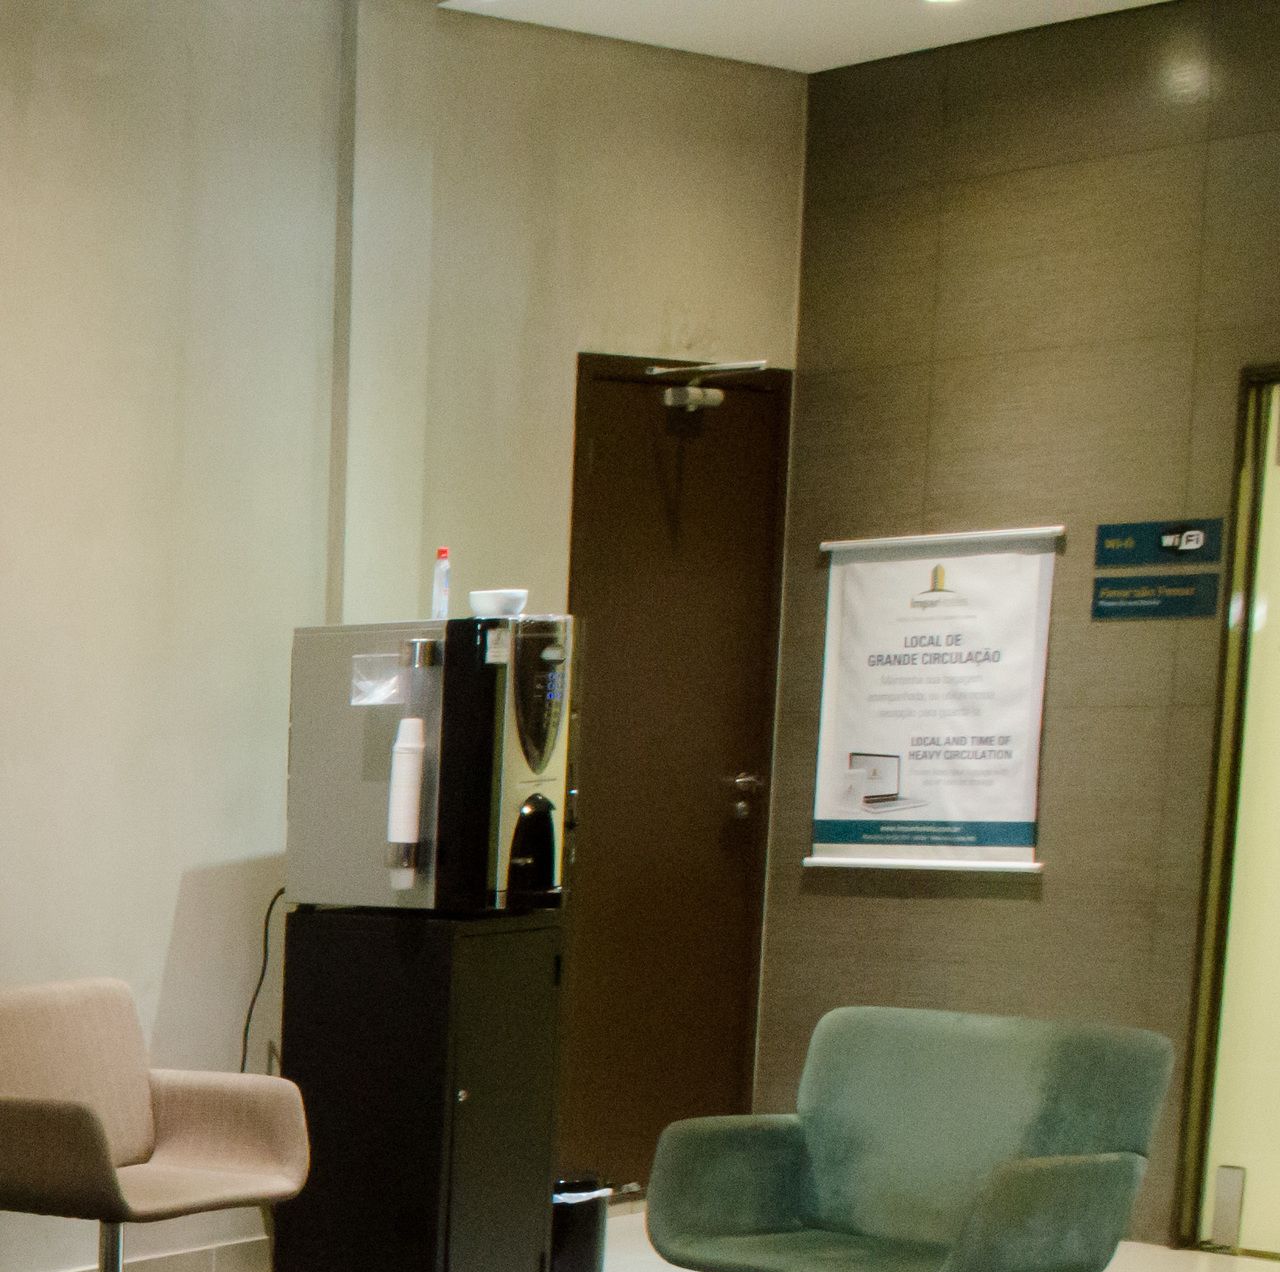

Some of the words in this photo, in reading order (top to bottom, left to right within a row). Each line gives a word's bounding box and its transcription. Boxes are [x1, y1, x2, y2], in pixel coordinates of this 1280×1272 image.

[904, 635, 942, 648] LOCAL
[945, 634, 963, 647] DE
[867, 653, 918, 667] GRANDE
[921, 647, 1002, 667] CIRCULAÇÃO
[910, 736, 941, 747] LOCAL
[943, 736, 968, 746] AND
[971, 736, 995, 746] TIME
[998, 735, 1011, 746] OF
[908, 750, 941, 760] HEAVY
[944, 750, 1013, 760] CIRCULATION
